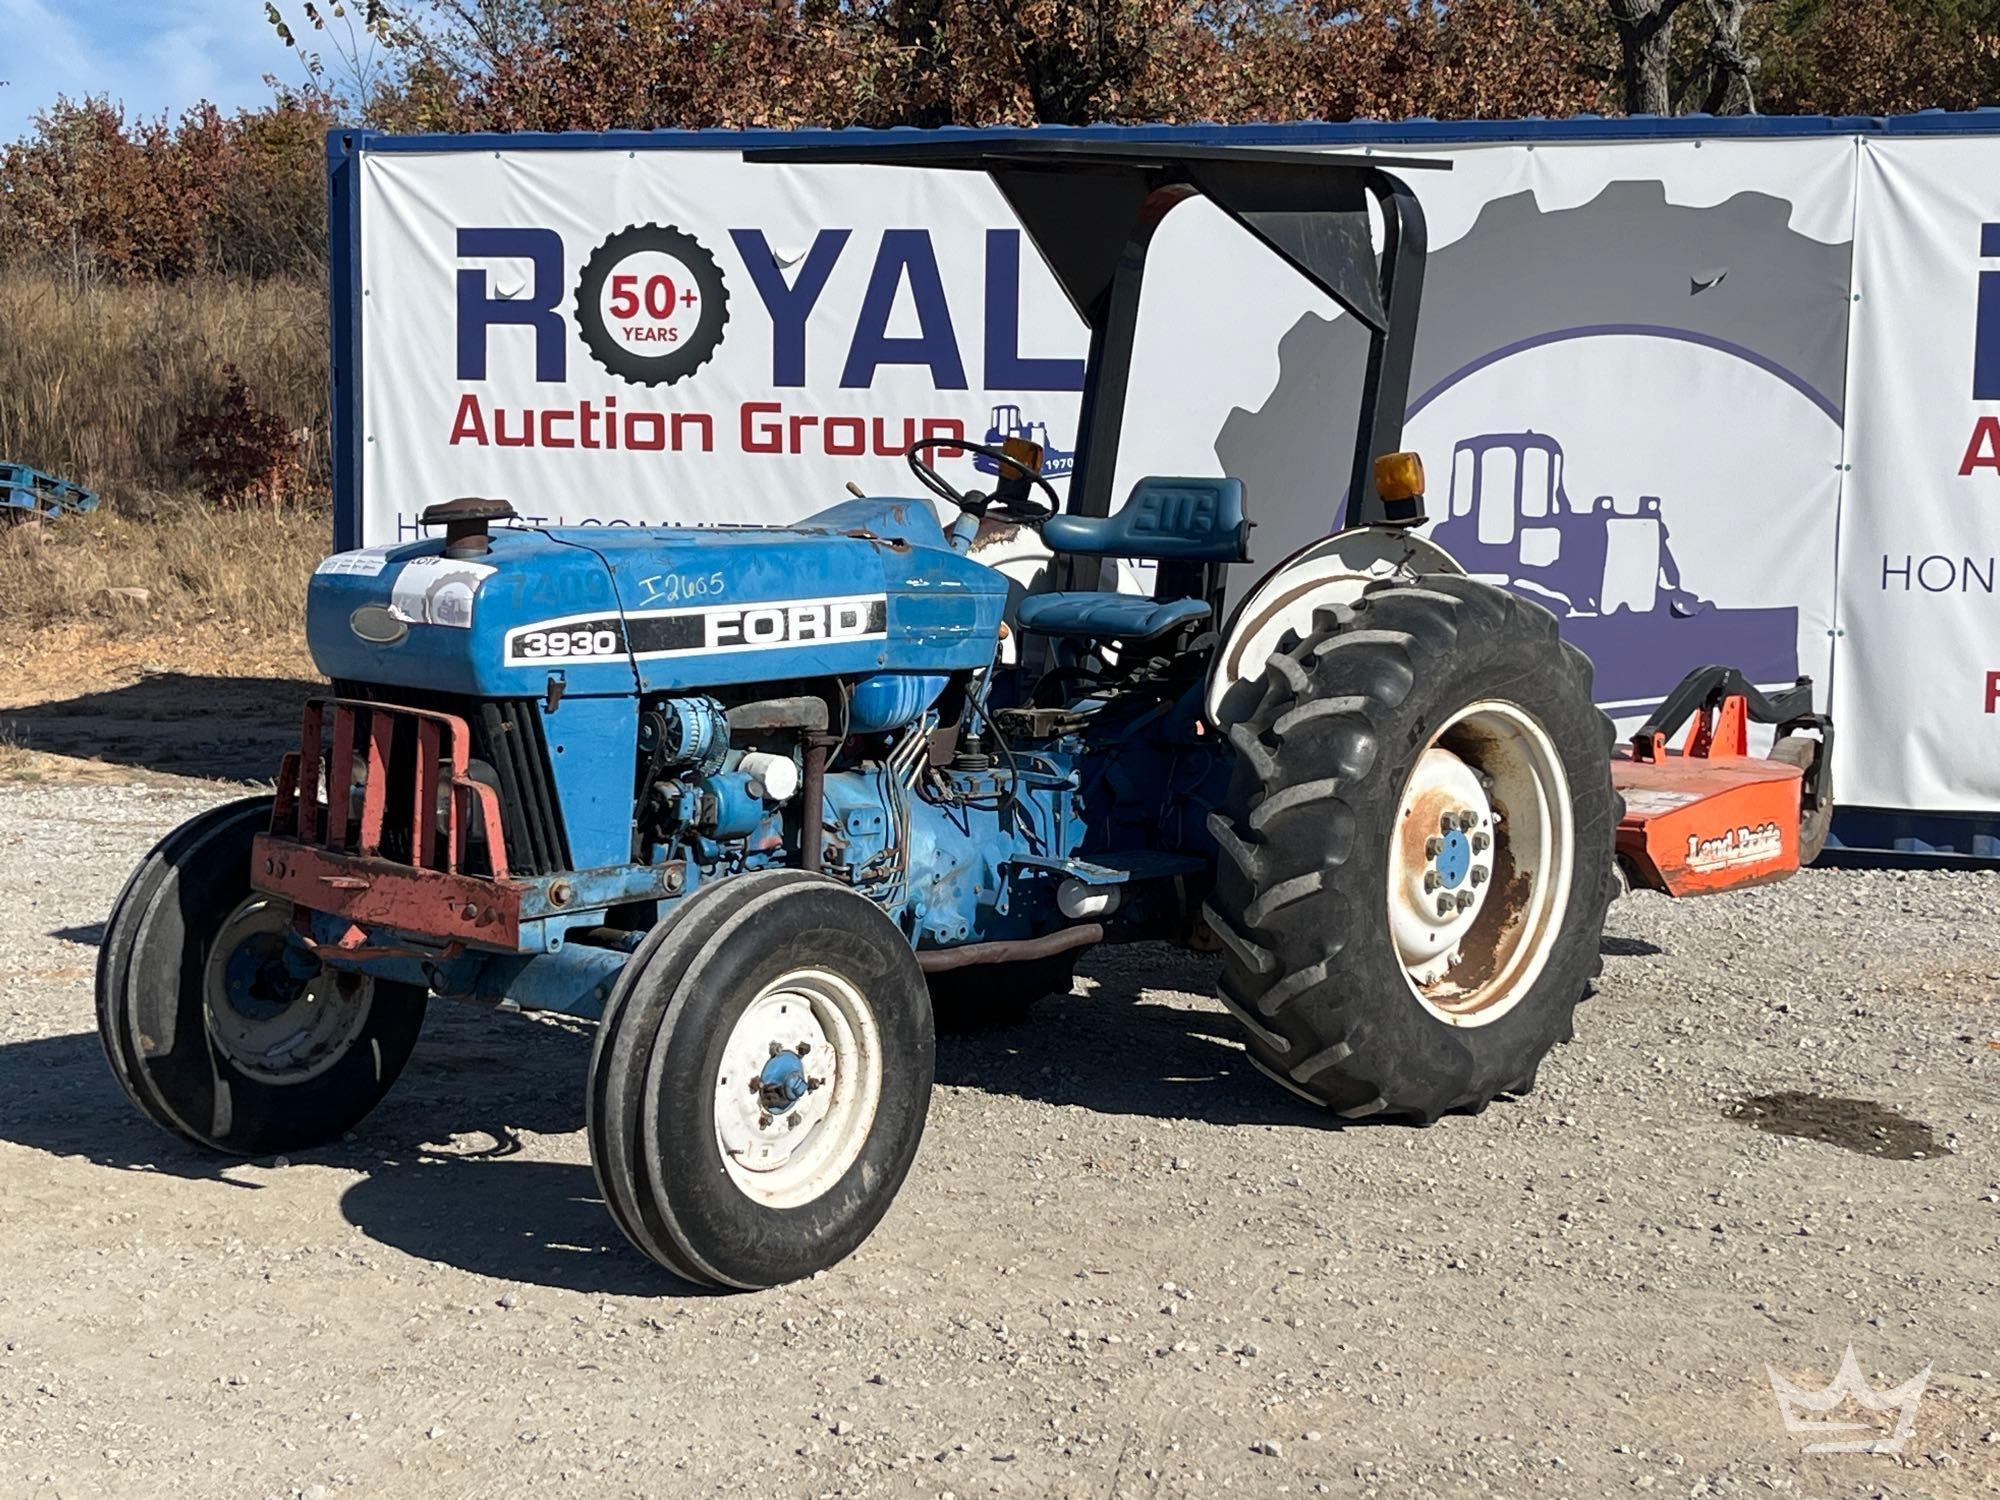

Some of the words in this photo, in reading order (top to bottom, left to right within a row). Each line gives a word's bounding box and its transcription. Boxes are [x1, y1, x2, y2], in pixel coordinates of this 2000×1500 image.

[609, 274, 698, 320] 50+
[622, 327, 678, 342] YEARS
[448, 394, 714, 452] Auction
[740, 402, 965, 471] Group
[1045, 458, 1074, 471] 1970
[705, 602, 869, 647] FORD
[524, 630, 616, 657] 3930
